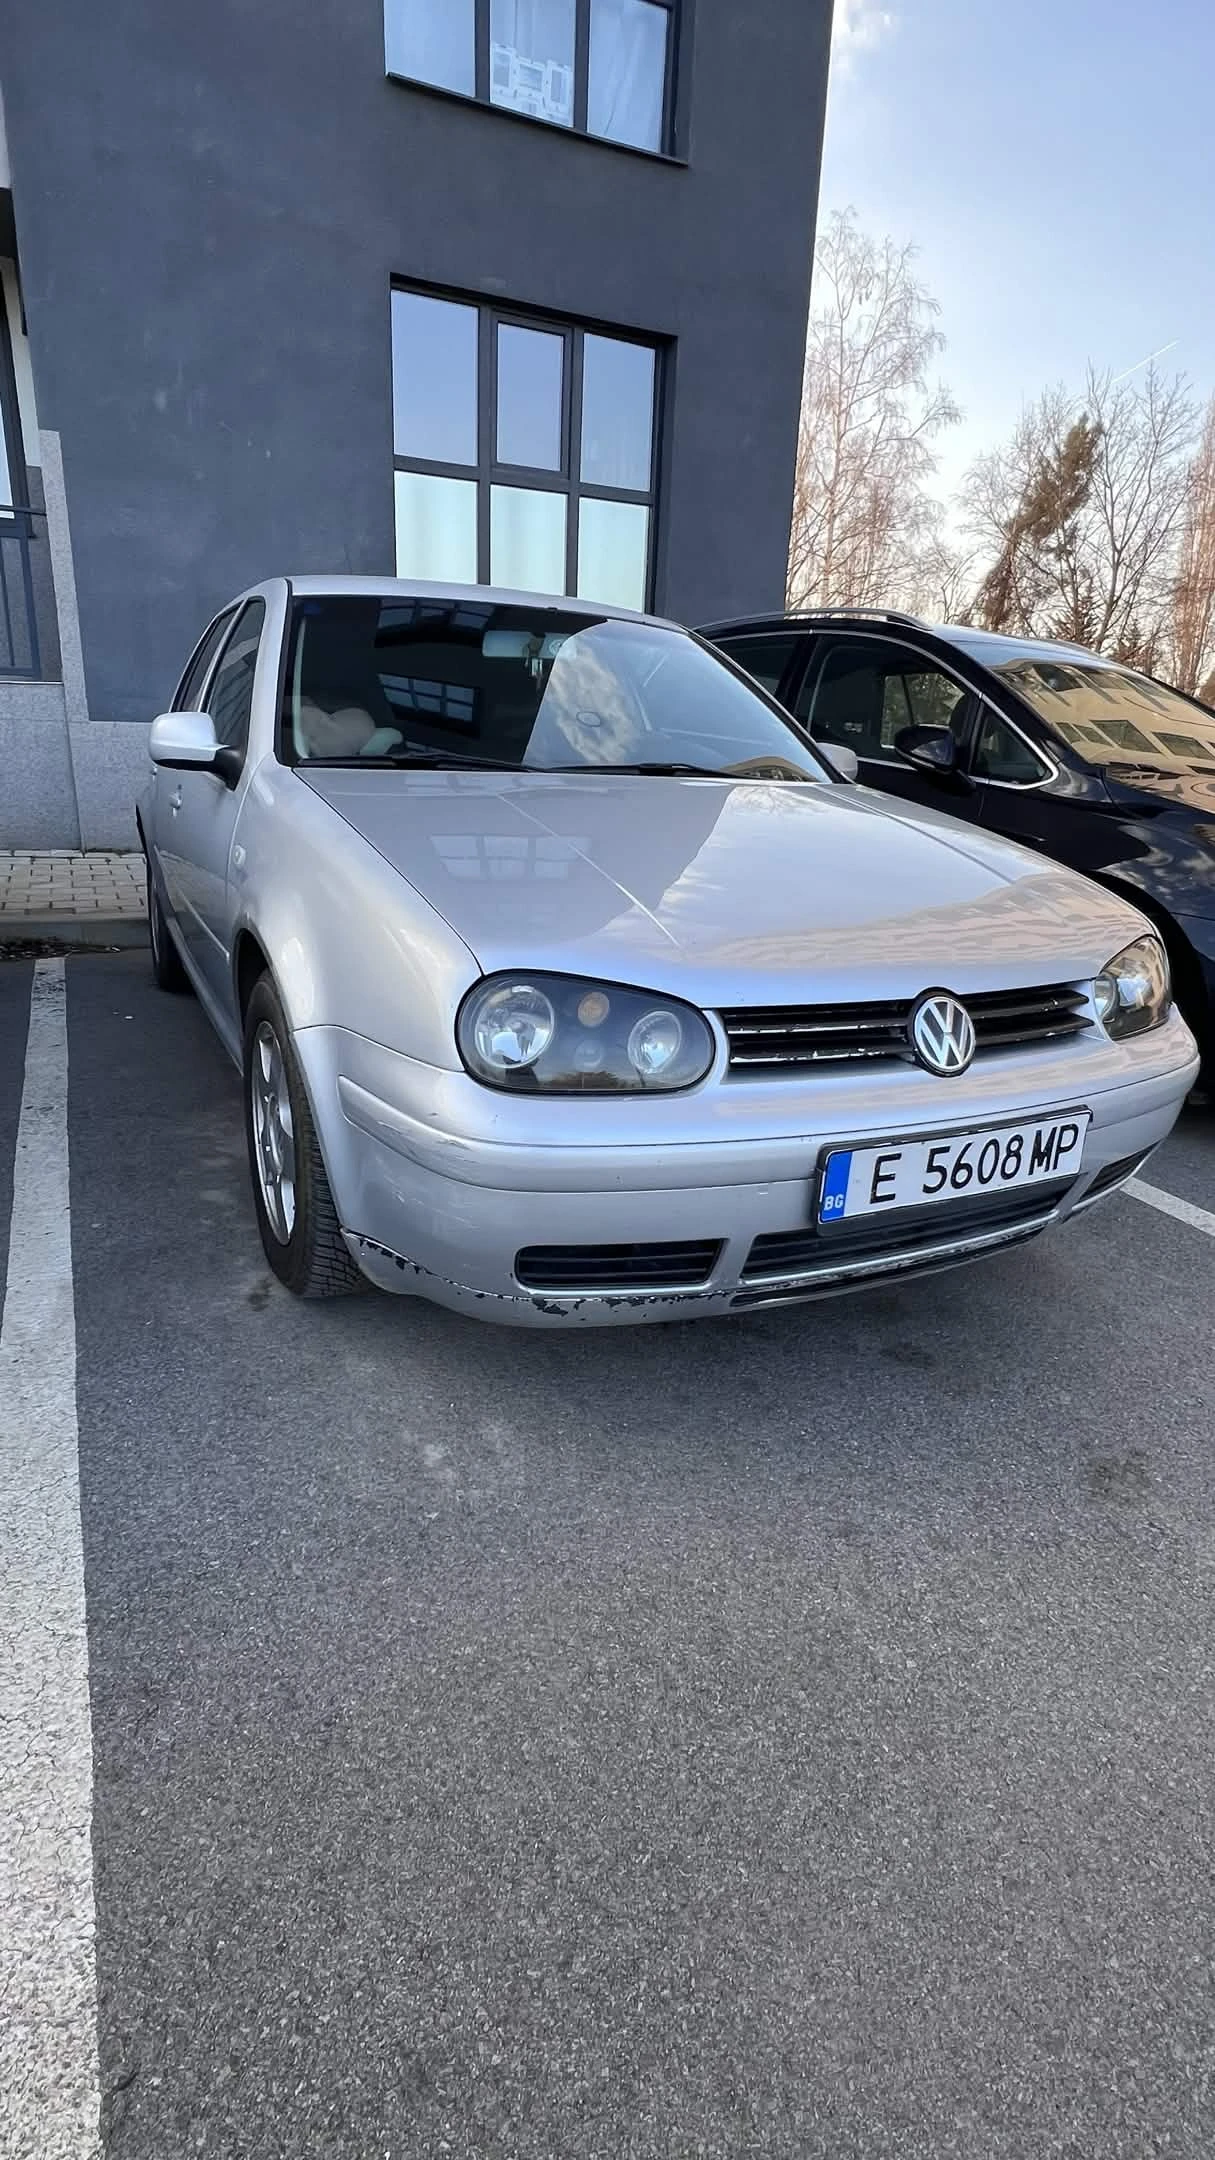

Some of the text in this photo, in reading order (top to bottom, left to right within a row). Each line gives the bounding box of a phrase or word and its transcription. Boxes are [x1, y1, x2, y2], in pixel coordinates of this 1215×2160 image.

[915, 996, 975, 1071] VW
[870, 1123, 1079, 1205] E 5608 MP
[824, 1194, 844, 1211] BG
